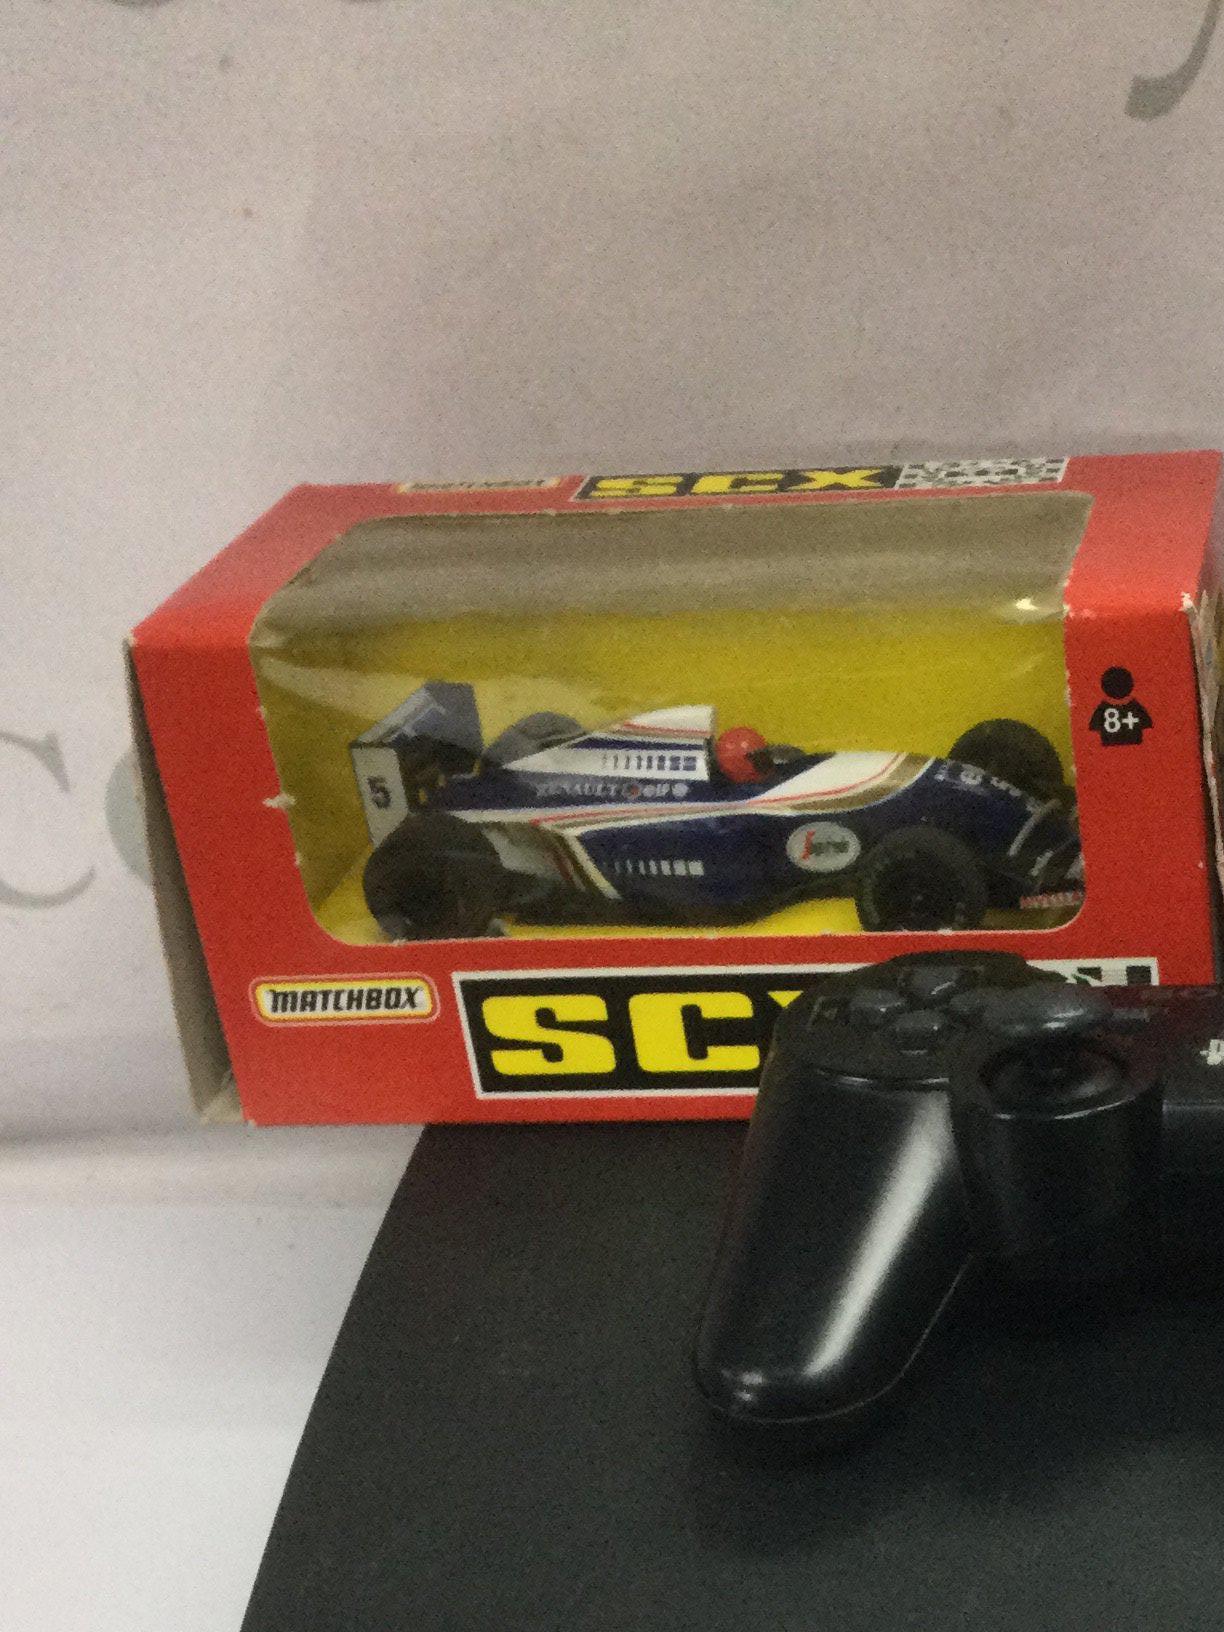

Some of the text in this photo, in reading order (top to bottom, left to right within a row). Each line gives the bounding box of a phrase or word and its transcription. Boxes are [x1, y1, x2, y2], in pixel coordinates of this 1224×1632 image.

[589, 468, 884, 497] SCX
[1103, 709, 1140, 732] 8+
[366, 775, 391, 810] 5
[269, 986, 423, 1014] MATCHBOX
[482, 990, 803, 1076] SC
